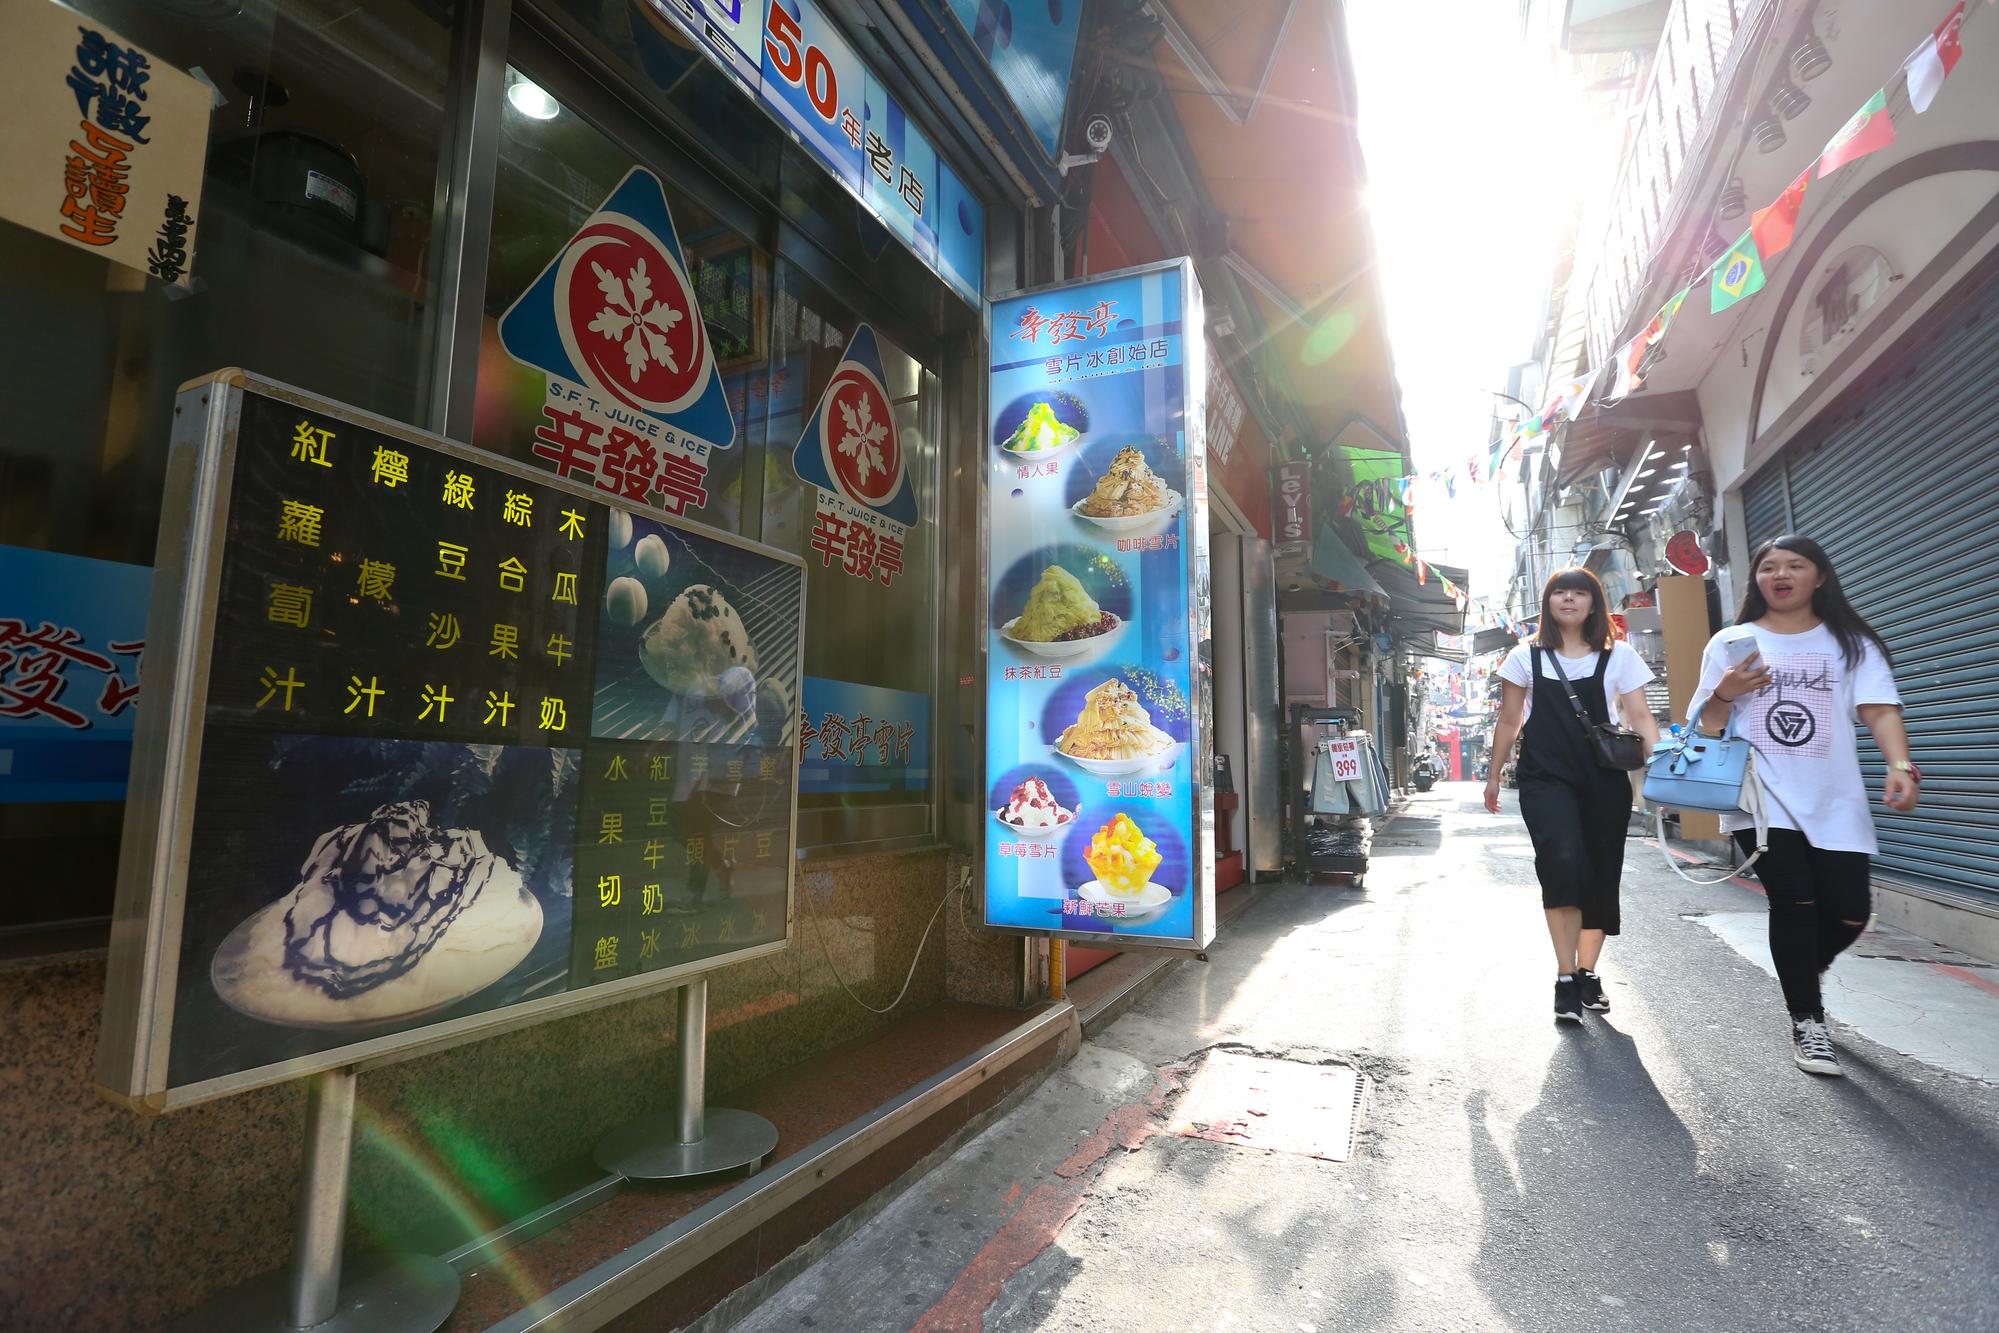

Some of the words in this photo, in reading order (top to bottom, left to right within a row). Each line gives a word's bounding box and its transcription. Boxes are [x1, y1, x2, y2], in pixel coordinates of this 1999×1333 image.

[1010, 301, 1119, 344] 辛發亭
[1045, 339, 1169, 376] 雪片冰創始店
[532, 405, 709, 518] 辛發亭
[604, 408, 660, 437] JUICE
[664, 431, 676, 445] &
[680, 437, 708, 457] ICE
[1016, 462, 1059, 480] 情人果
[811, 511, 905, 586] 辛發亭
[847, 507, 878, 525] JUICE
[879, 519, 886, 528] &
[888, 524, 904, 536] ICE
[256, 420, 337, 712] 紅蘿蔔汁
[343, 445, 410, 718] 檸檬汁
[418, 469, 477, 723] 綠豆沙汁
[483, 489, 534, 727] 綜合果汁
[538, 508, 586, 732] 木瓜牛奶
[1003, 664, 1063, 681] 抹茶紅豆
[1336, 759, 1356, 777] 399
[593, 755, 629, 970] 水果切盤
[639, 755, 672, 960] 紅豆牛奶冰
[999, 841, 1058, 859] 草莓雪片
[1062, 899, 1128, 918] 新鮮芒果
